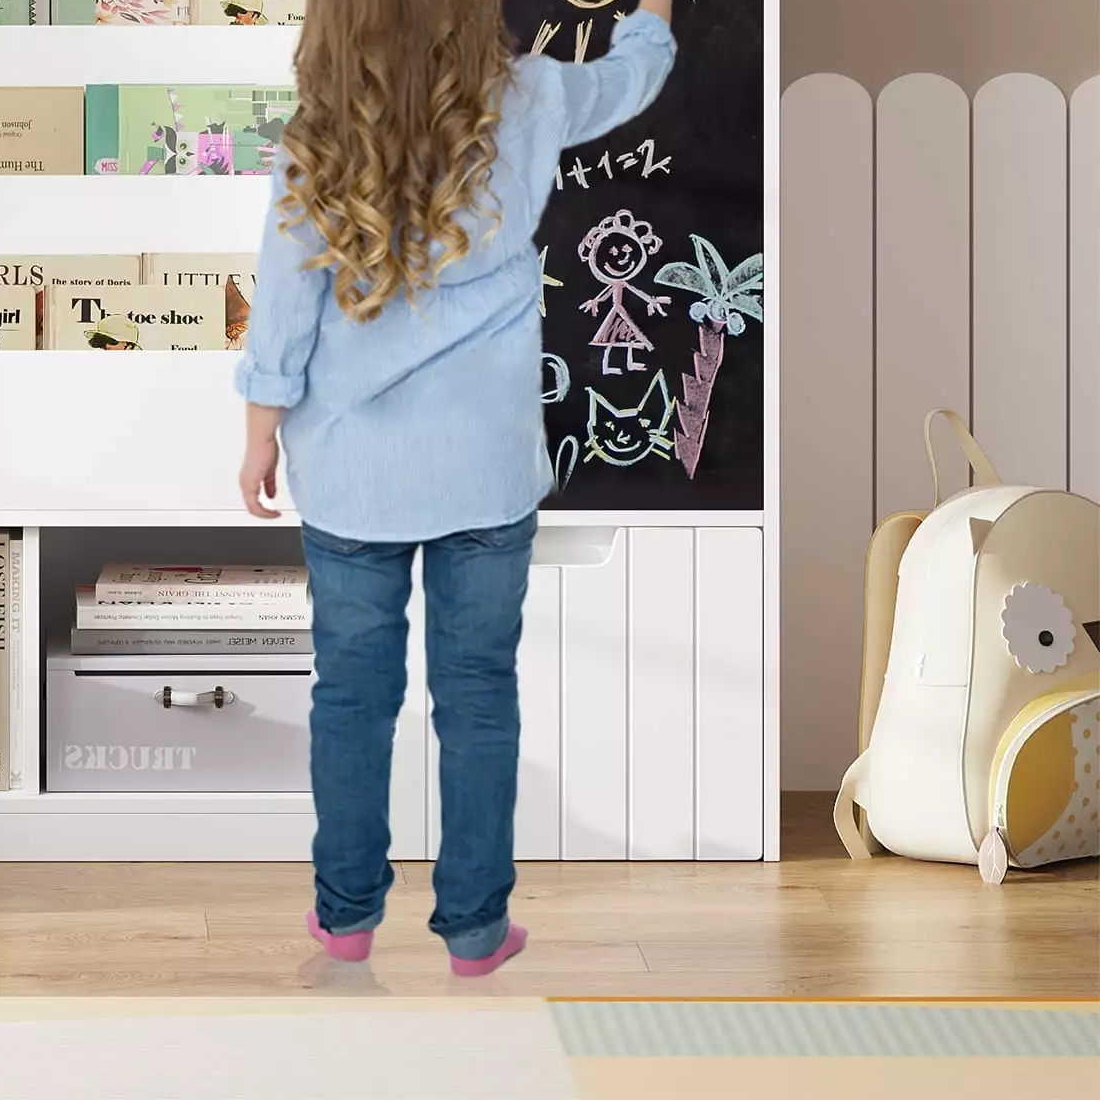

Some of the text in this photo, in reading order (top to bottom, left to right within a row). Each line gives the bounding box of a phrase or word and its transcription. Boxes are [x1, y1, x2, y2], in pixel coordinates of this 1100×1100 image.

[2, 120, 32, 130] Johnson
[25, 161, 44, 171] The
[161, 310, 204, 325] shoe
[12, 552, 20, 613] MAKING
[12, 617, 20, 632] IT
